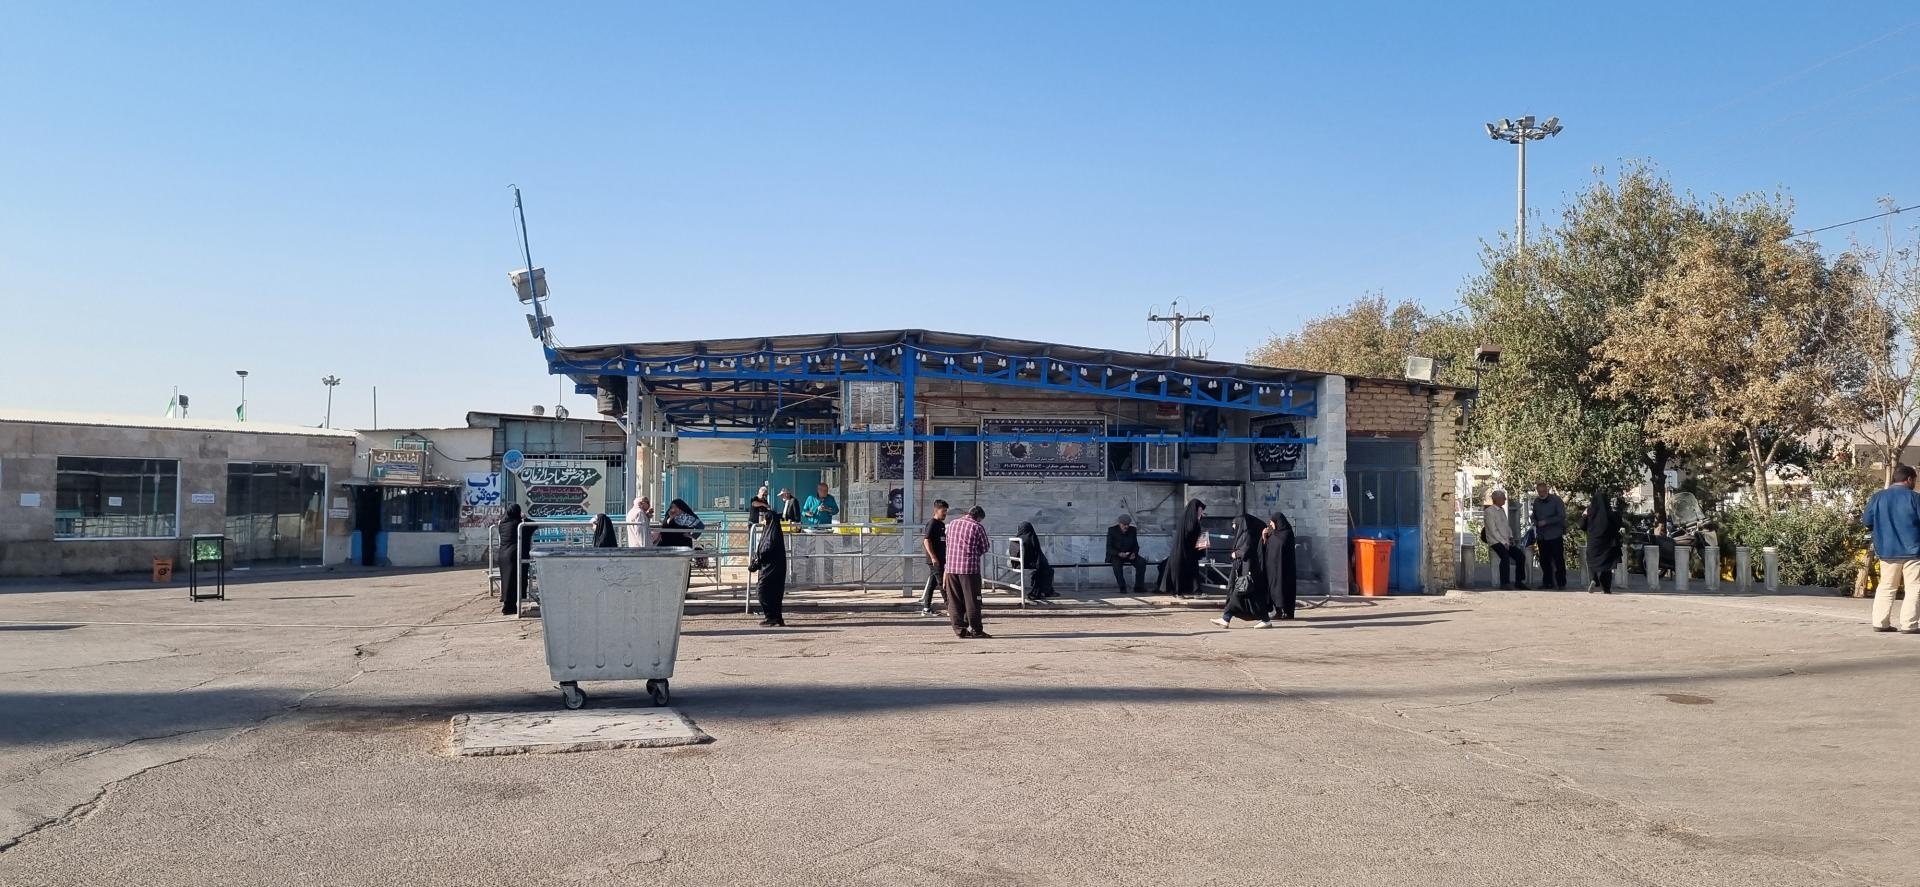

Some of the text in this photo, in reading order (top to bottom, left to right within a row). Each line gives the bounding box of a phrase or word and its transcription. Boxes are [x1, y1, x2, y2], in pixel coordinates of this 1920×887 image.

[374, 452, 420, 464] امانتداری
[467, 473, 499, 490] آب
[520, 467, 548, 481] الزمان
[562, 468, 584, 485] حضرت
[580, 469, 598, 485] سفره
[469, 488, 501, 505] جوش
